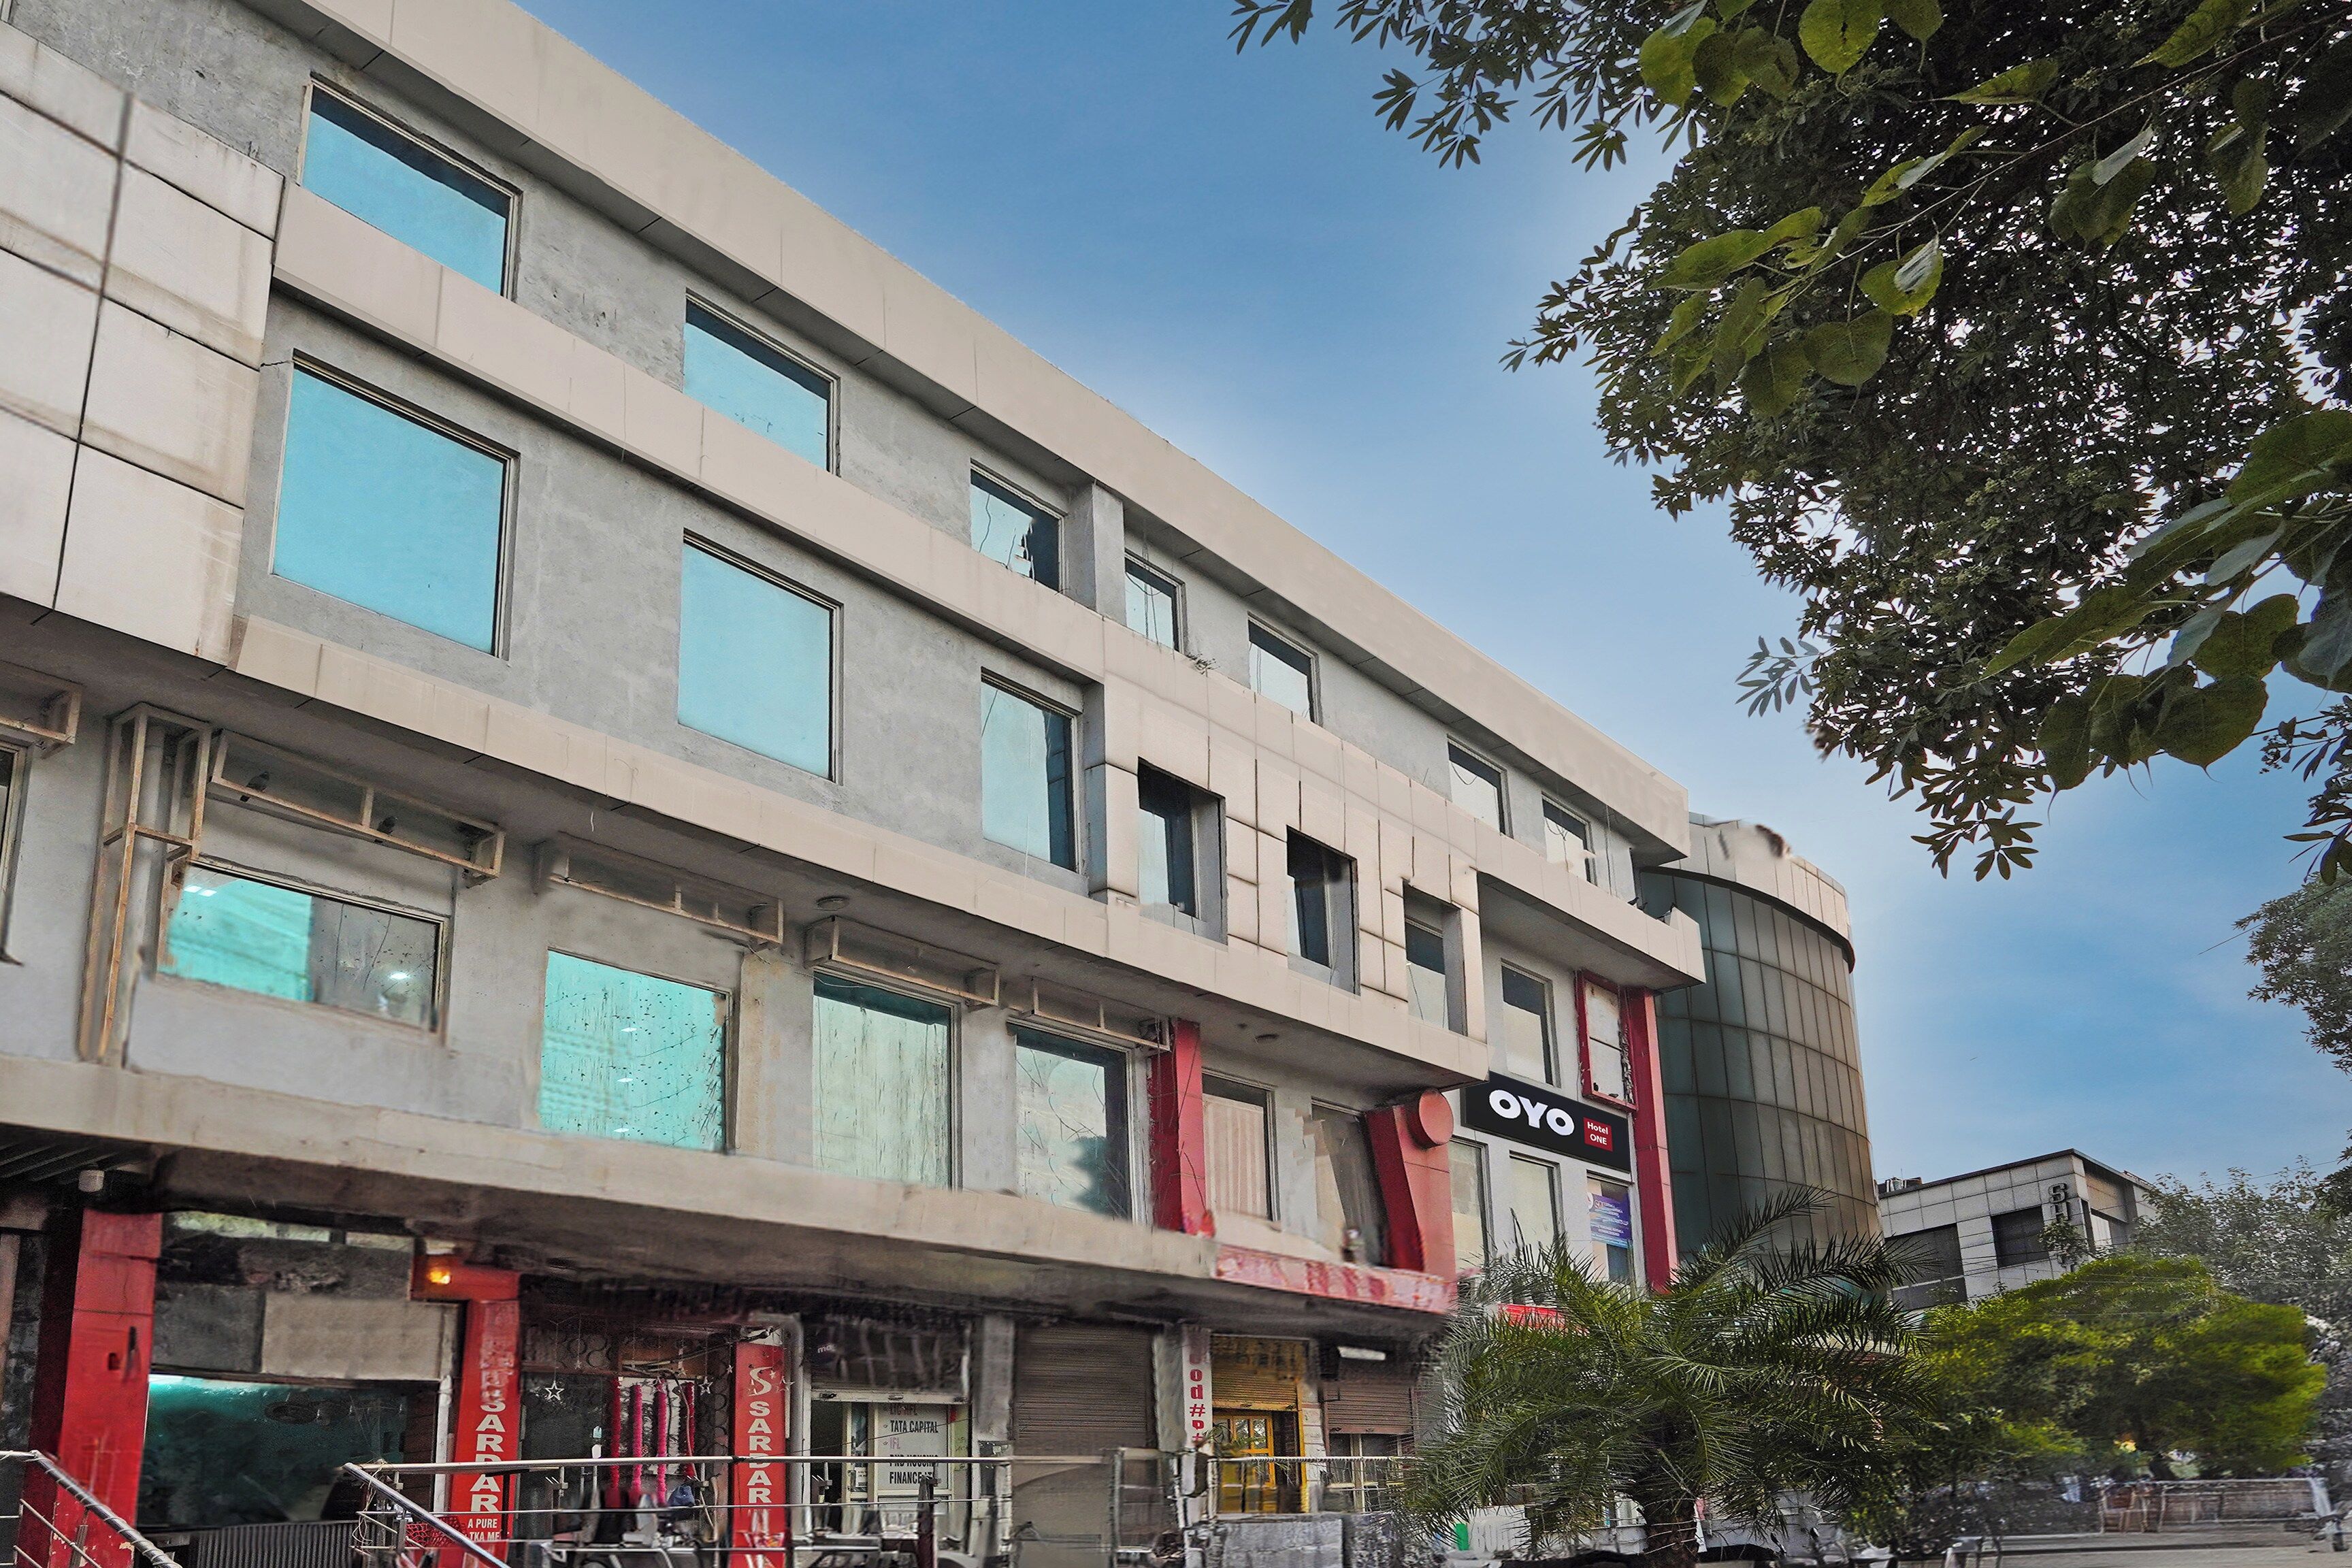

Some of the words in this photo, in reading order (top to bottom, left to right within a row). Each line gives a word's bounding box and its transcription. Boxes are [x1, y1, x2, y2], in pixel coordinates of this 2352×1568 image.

[1489, 1090, 1575, 1136] OYO
[1587, 1122, 1608, 1134] Hotel
[1590, 1134, 1607, 1145] ONE
[890, 1420, 907, 1433] TATA
[909, 1420, 938, 1433] CAPITAL
[747, 1401, 772, 1504] SARDAR
[889, 1471, 922, 1484] FINANCE
[468, 1518, 473, 1529] A
[476, 1518, 497, 1529] PURE
